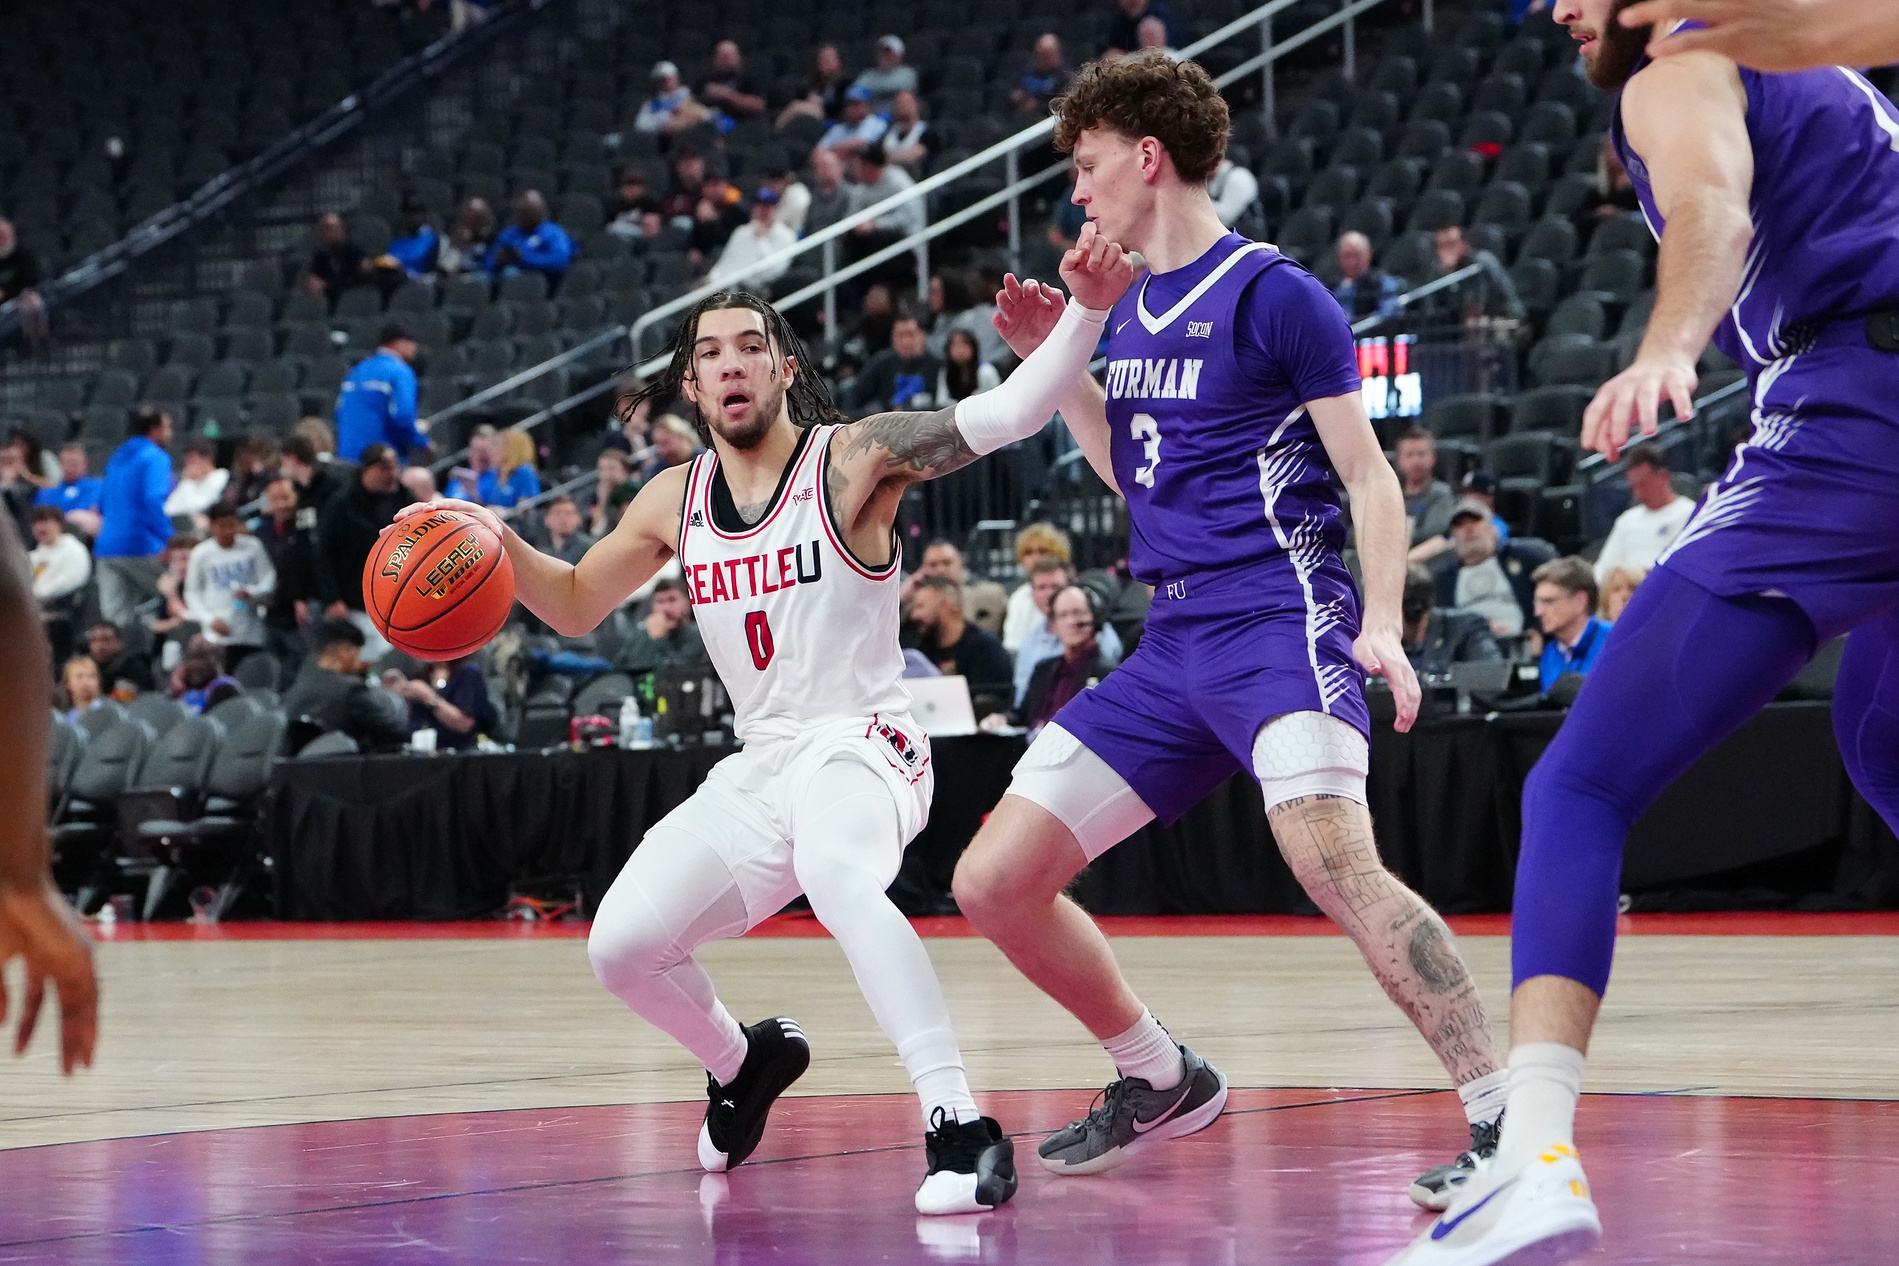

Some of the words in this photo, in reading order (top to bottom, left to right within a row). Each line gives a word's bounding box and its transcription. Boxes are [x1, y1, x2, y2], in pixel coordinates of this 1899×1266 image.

[1186, 321, 1214, 338] SOCON
[1106, 358, 1203, 401] FURMAN
[1130, 413, 1162, 489] 3
[381, 512, 458, 583] SPALDING
[415, 533, 479, 597] LEGACY
[448, 548, 484, 585] 1000
[1166, 579, 1186, 600] FU
[744, 610, 775, 671] 0
